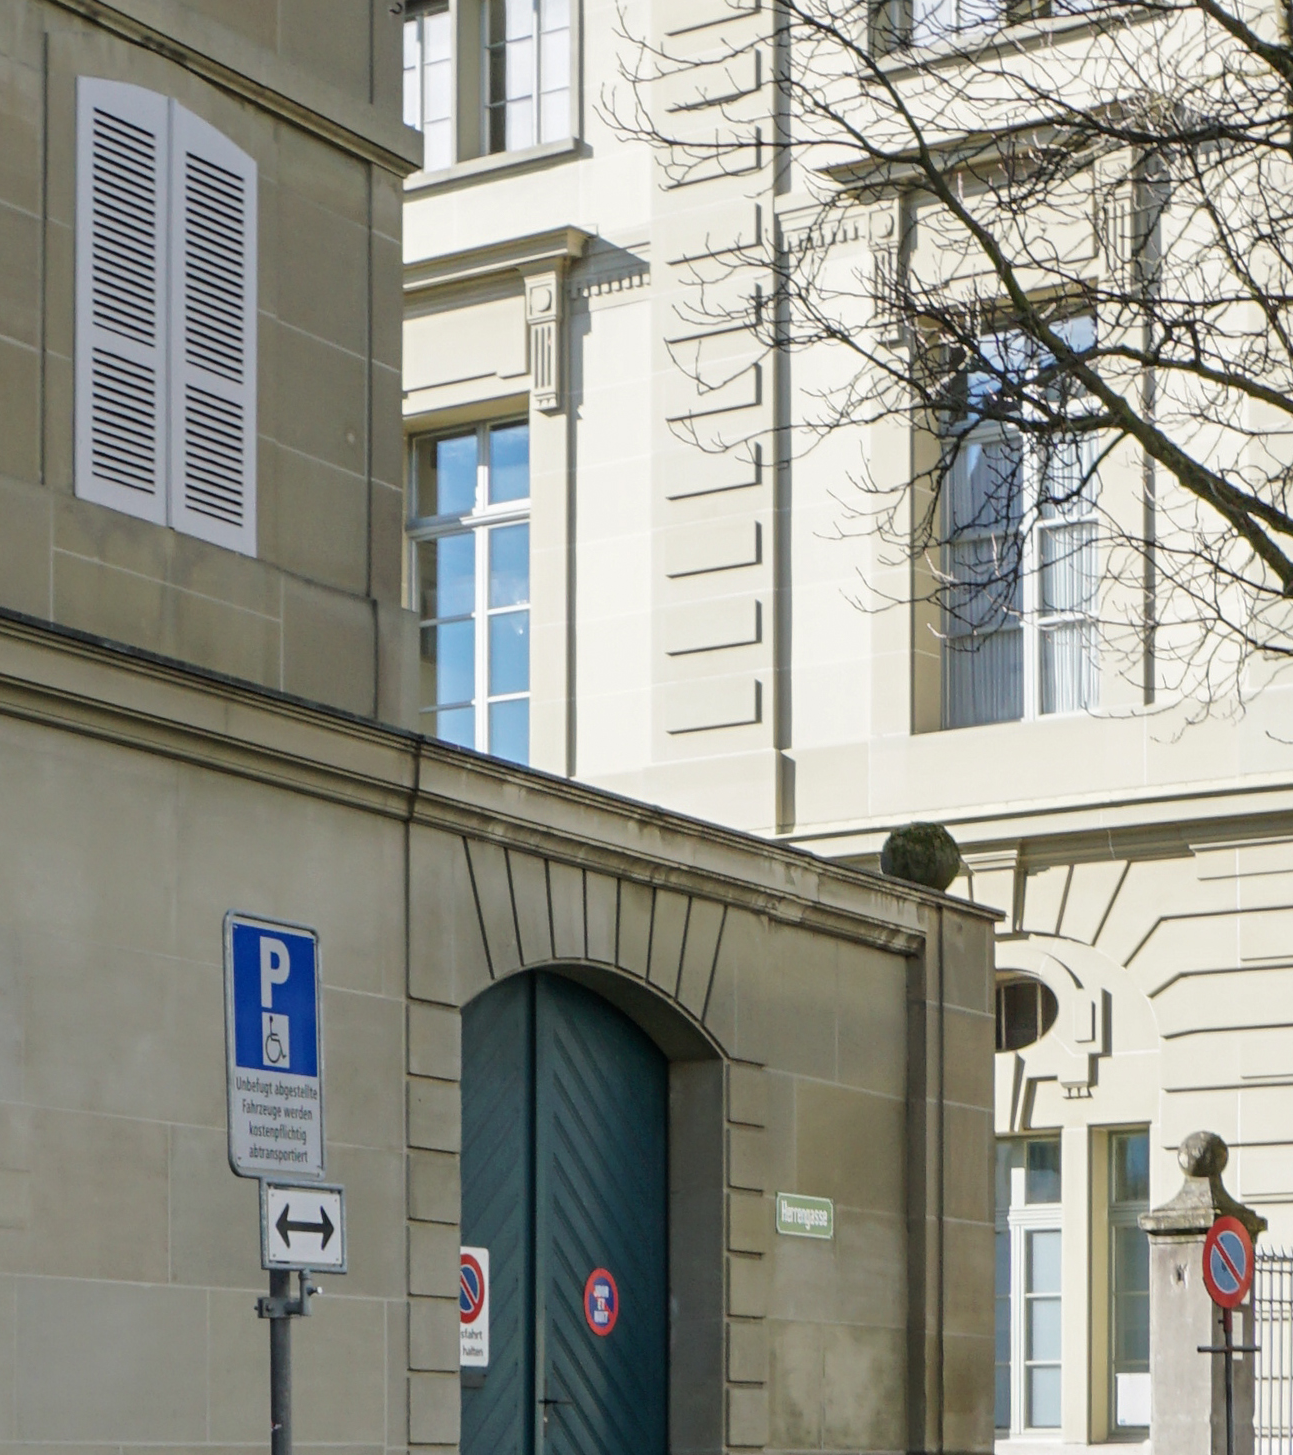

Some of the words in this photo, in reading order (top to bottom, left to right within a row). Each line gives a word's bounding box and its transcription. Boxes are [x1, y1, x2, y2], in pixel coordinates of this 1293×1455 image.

[259, 935, 291, 1009] P
[236, 1077, 272, 1098] Unbefugt
[274, 1080, 318, 1100] abgestellte
[242, 1098, 282, 1121] Fahrzeuge
[283, 1105, 313, 1120] werden
[249, 1120, 307, 1146] kostenpflichtig
[249, 1143, 308, 1164] abtransportiert
[781, 1199, 828, 1230] Herrengasse
